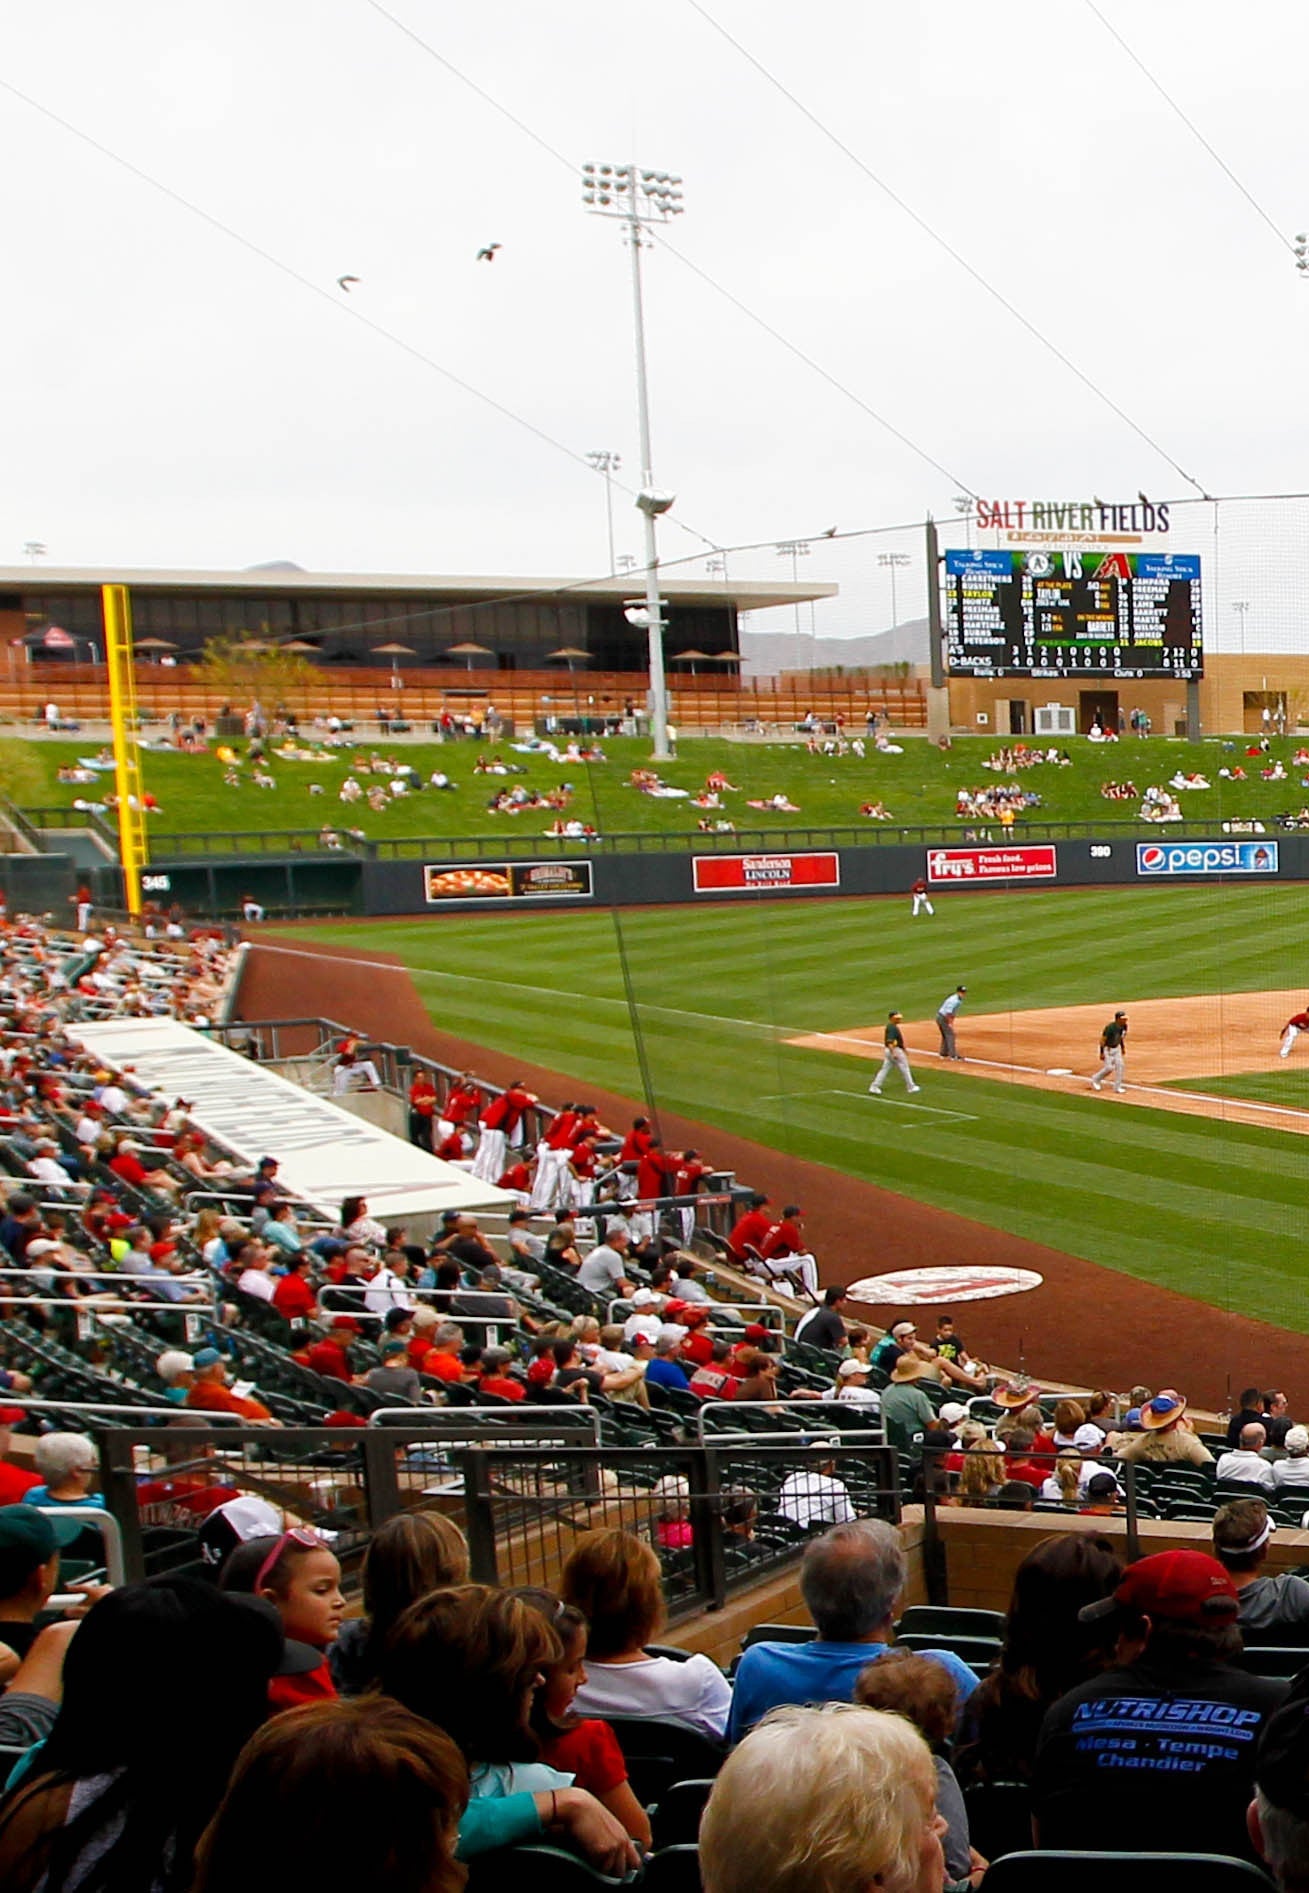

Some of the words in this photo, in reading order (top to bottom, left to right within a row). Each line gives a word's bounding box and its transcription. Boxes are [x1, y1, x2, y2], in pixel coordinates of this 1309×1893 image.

[976, 500, 1026, 529] SALT
[1032, 502, 1094, 531] RIVER
[1101, 504, 1169, 533] FIELDS
[1063, 551, 1083, 579] VS
[962, 590, 994, 599] TAYLOR
[1133, 624, 1166, 632] WILSON
[1134, 639, 1164, 647] JACOBS
[1012, 645, 1019, 656] 3
[1026, 645, 1033, 656] 1
[1040, 645, 1048, 656] 2
[1056, 646, 1063, 657] 1
[1069, 646, 1077, 657] 0
[1083, 646, 1091, 657] 0
[1098, 646, 1107, 657] 0
[1113, 646, 1121, 657] 0
[1162, 647, 1169, 657] 7
[1173, 647, 1185, 658] 12
[1190, 647, 1198, 658] 0
[948, 656, 993, 667] D-BACKS
[1012, 656, 1020, 667] 4
[1026, 656, 1034, 667] 0
[1040, 656, 1048, 667] 0
[1055, 657, 1064, 667] 0
[1071, 657, 1078, 668] 1
[1084, 657, 1092, 668] 0
[1099, 657, 1107, 668] 0
[1113, 657, 1121, 668] 3
[1173, 658, 1185, 669] 11
[1190, 658, 1198, 668] 0
[742, 857, 792, 869] Sanderson
[978, 855, 1001, 863] Fresh
[1168, 843, 1240, 873] pepsi
[745, 869, 791, 881] LINCOLN
[979, 865, 1010, 874] Famous
[1011, 863, 1025, 873] low
[141, 875, 171, 892] 345
[1072, 1700, 1262, 1727] NUTRISHOP
[1076, 1736, 1137, 1751] Mesa
[1157, 1738, 1240, 1761] Tempe
[1096, 1752, 1208, 1772] Chandler
